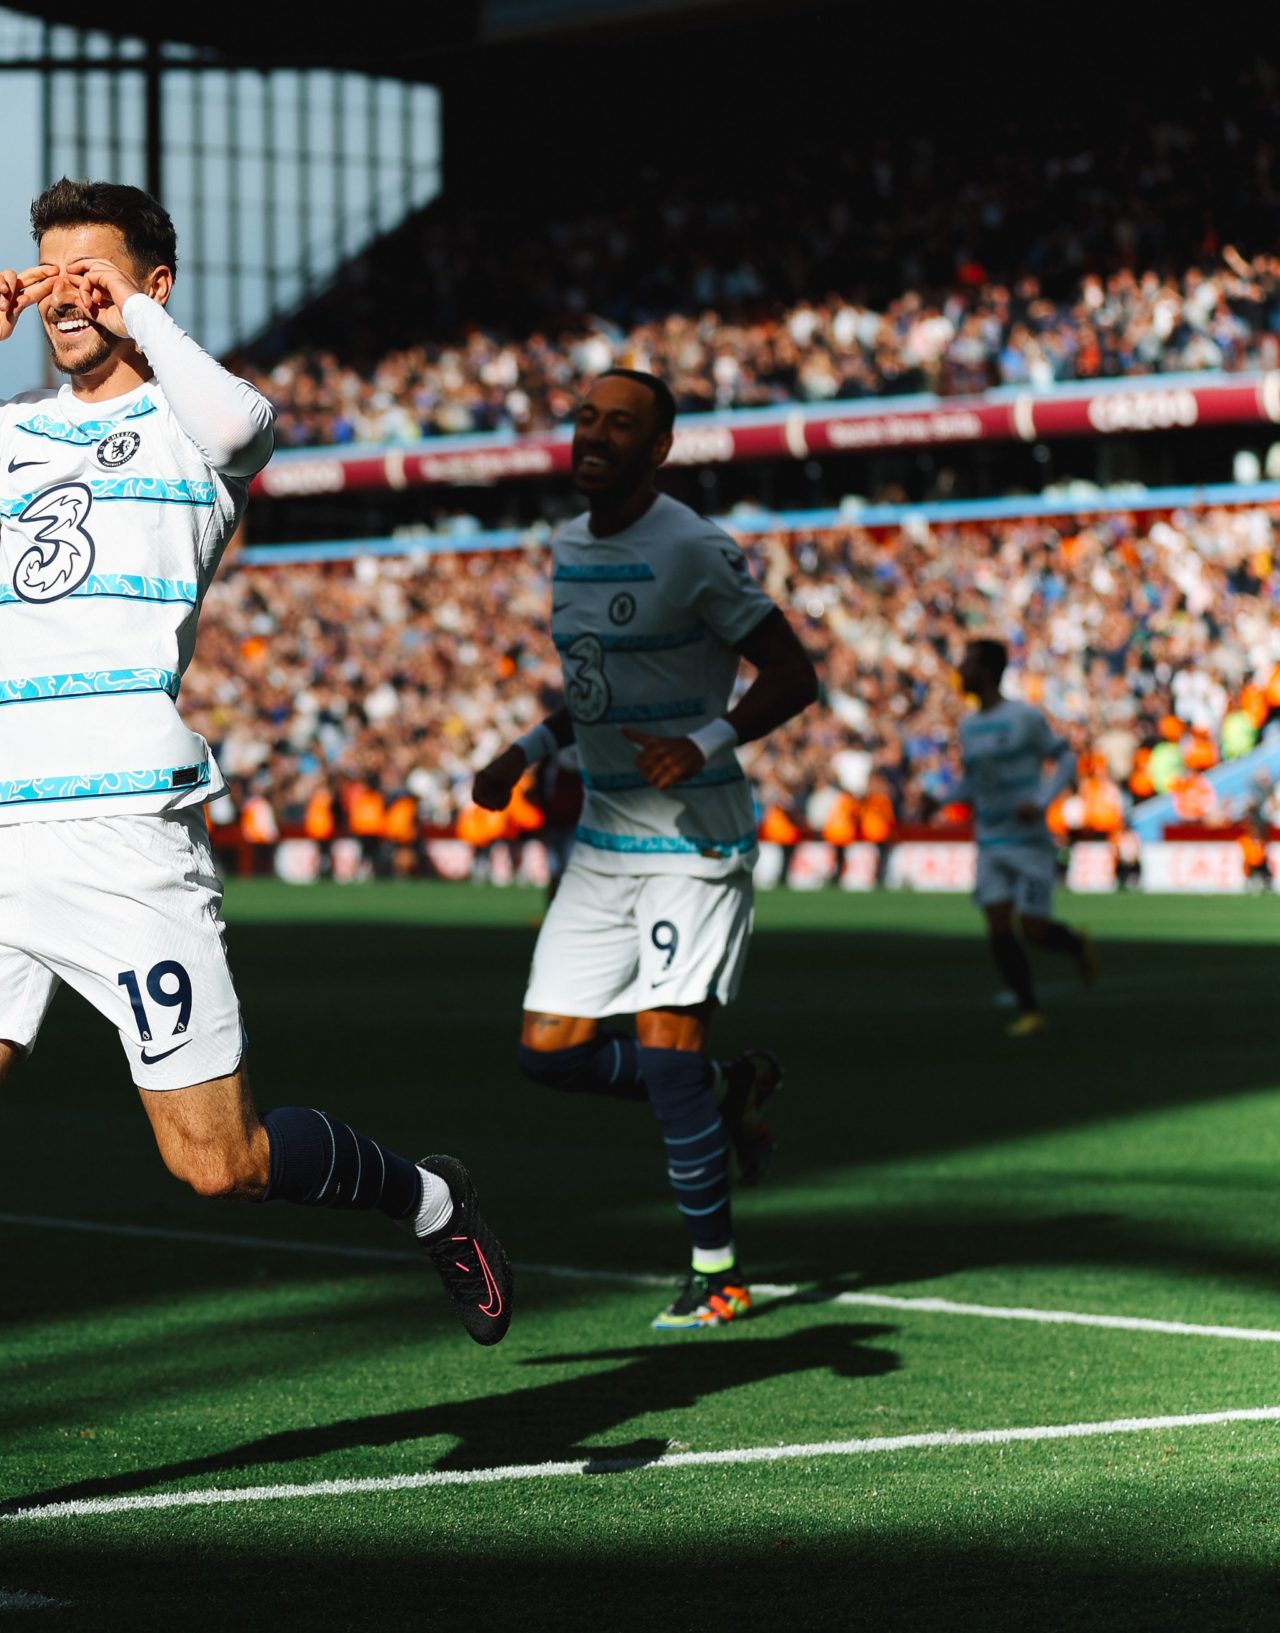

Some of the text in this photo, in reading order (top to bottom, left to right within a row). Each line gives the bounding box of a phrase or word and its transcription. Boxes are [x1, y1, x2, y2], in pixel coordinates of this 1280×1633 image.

[13, 481, 96, 604] 3
[566, 632, 612, 724] 3
[651, 920, 679, 971] 9
[117, 960, 193, 1042] 19
